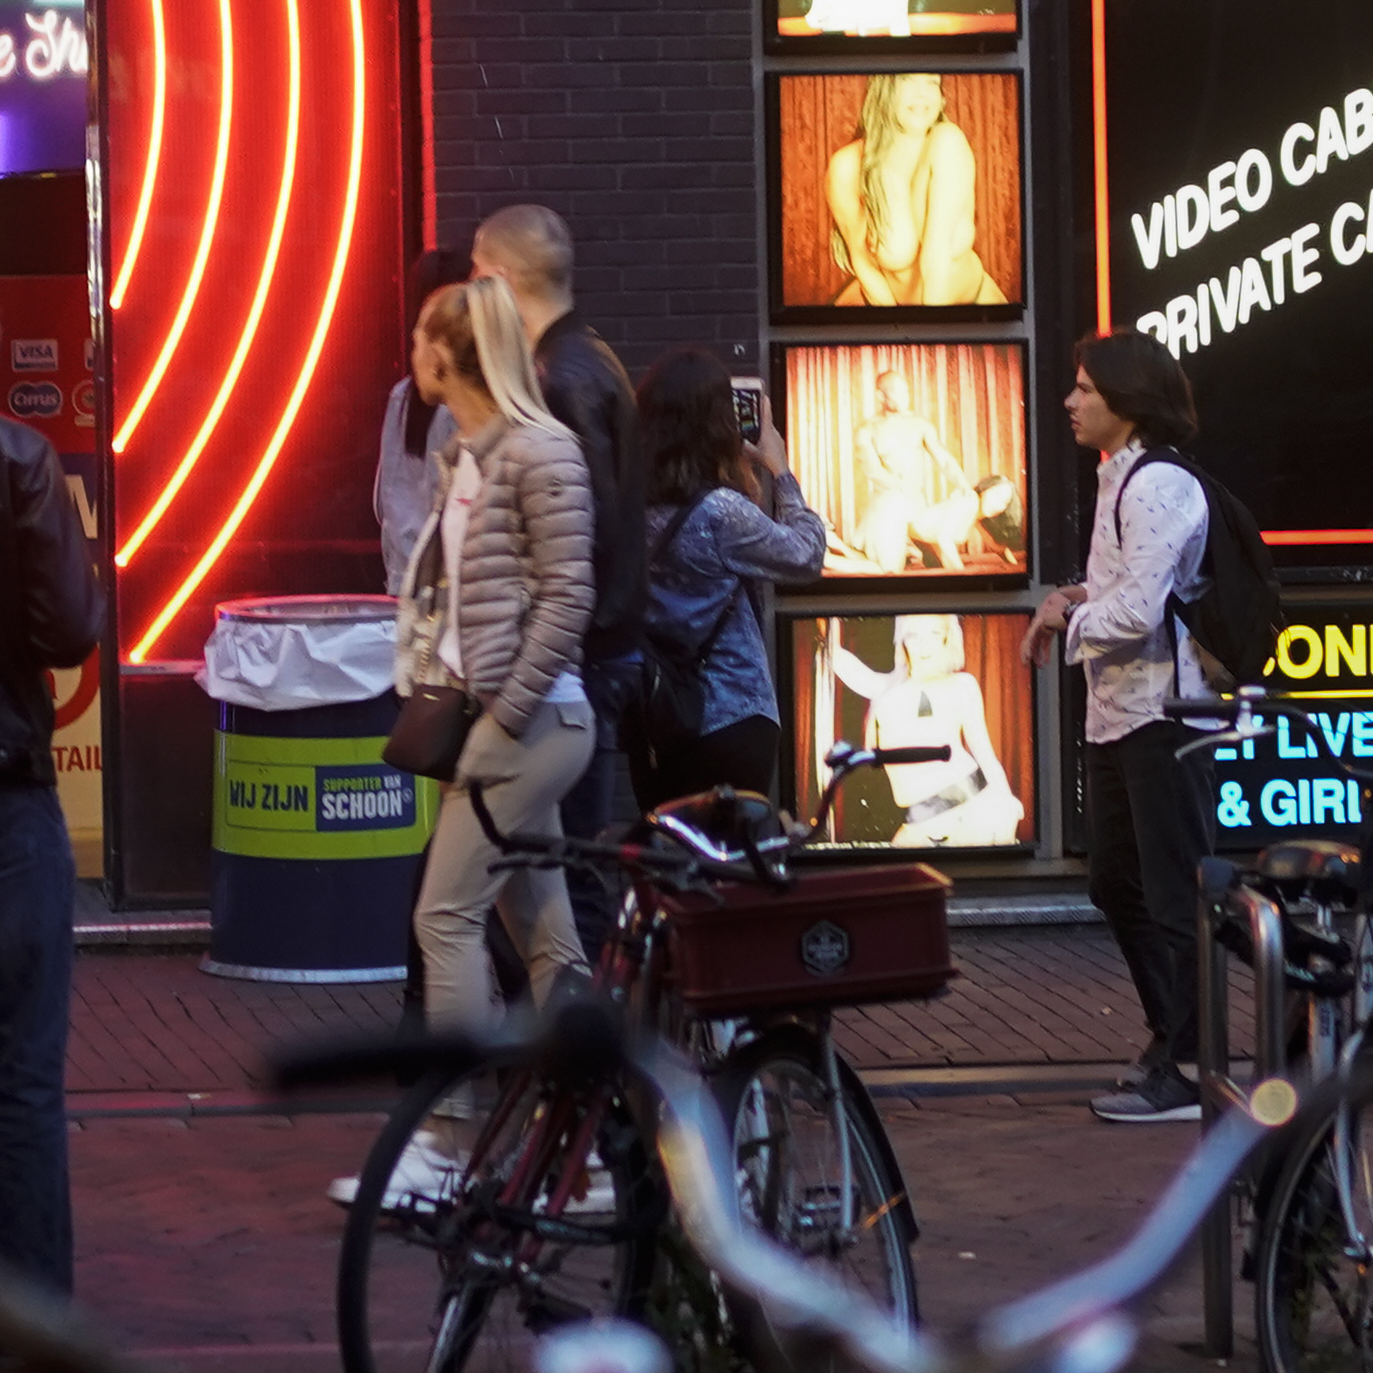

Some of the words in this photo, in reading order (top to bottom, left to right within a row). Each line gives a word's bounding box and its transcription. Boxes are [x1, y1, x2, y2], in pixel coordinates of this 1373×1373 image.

[1131, 148, 1273, 270] VIDEO
[1135, 223, 1323, 361] PRIVATE
[230, 780, 257, 809] WIJ
[261, 783, 309, 812] ZIJN
[323, 776, 382, 793] SUPPORTER
[383, 774, 402, 789] VAN
[1217, 780, 1253, 828] &
